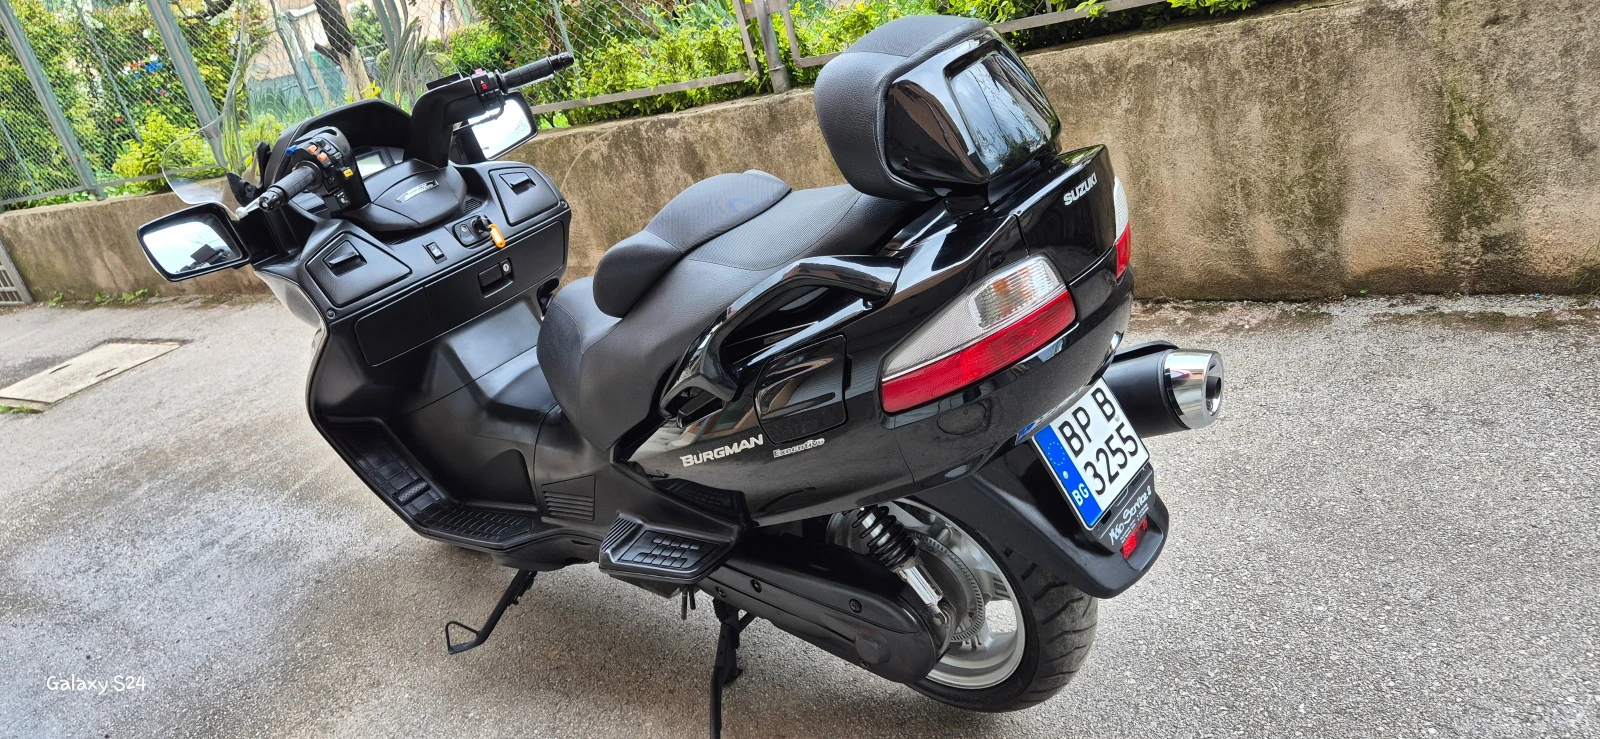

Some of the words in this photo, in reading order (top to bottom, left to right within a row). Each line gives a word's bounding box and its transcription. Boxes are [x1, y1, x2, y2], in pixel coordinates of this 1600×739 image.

[1063, 172, 1098, 206] SUZUKI
[1058, 406, 1092, 458] BP
[1090, 387, 1116, 423] B
[680, 434, 764, 467] BURGMAN
[773, 438, 825, 459] Executive
[1083, 422, 1139, 496] 3255
[1071, 483, 1090, 507] BG
